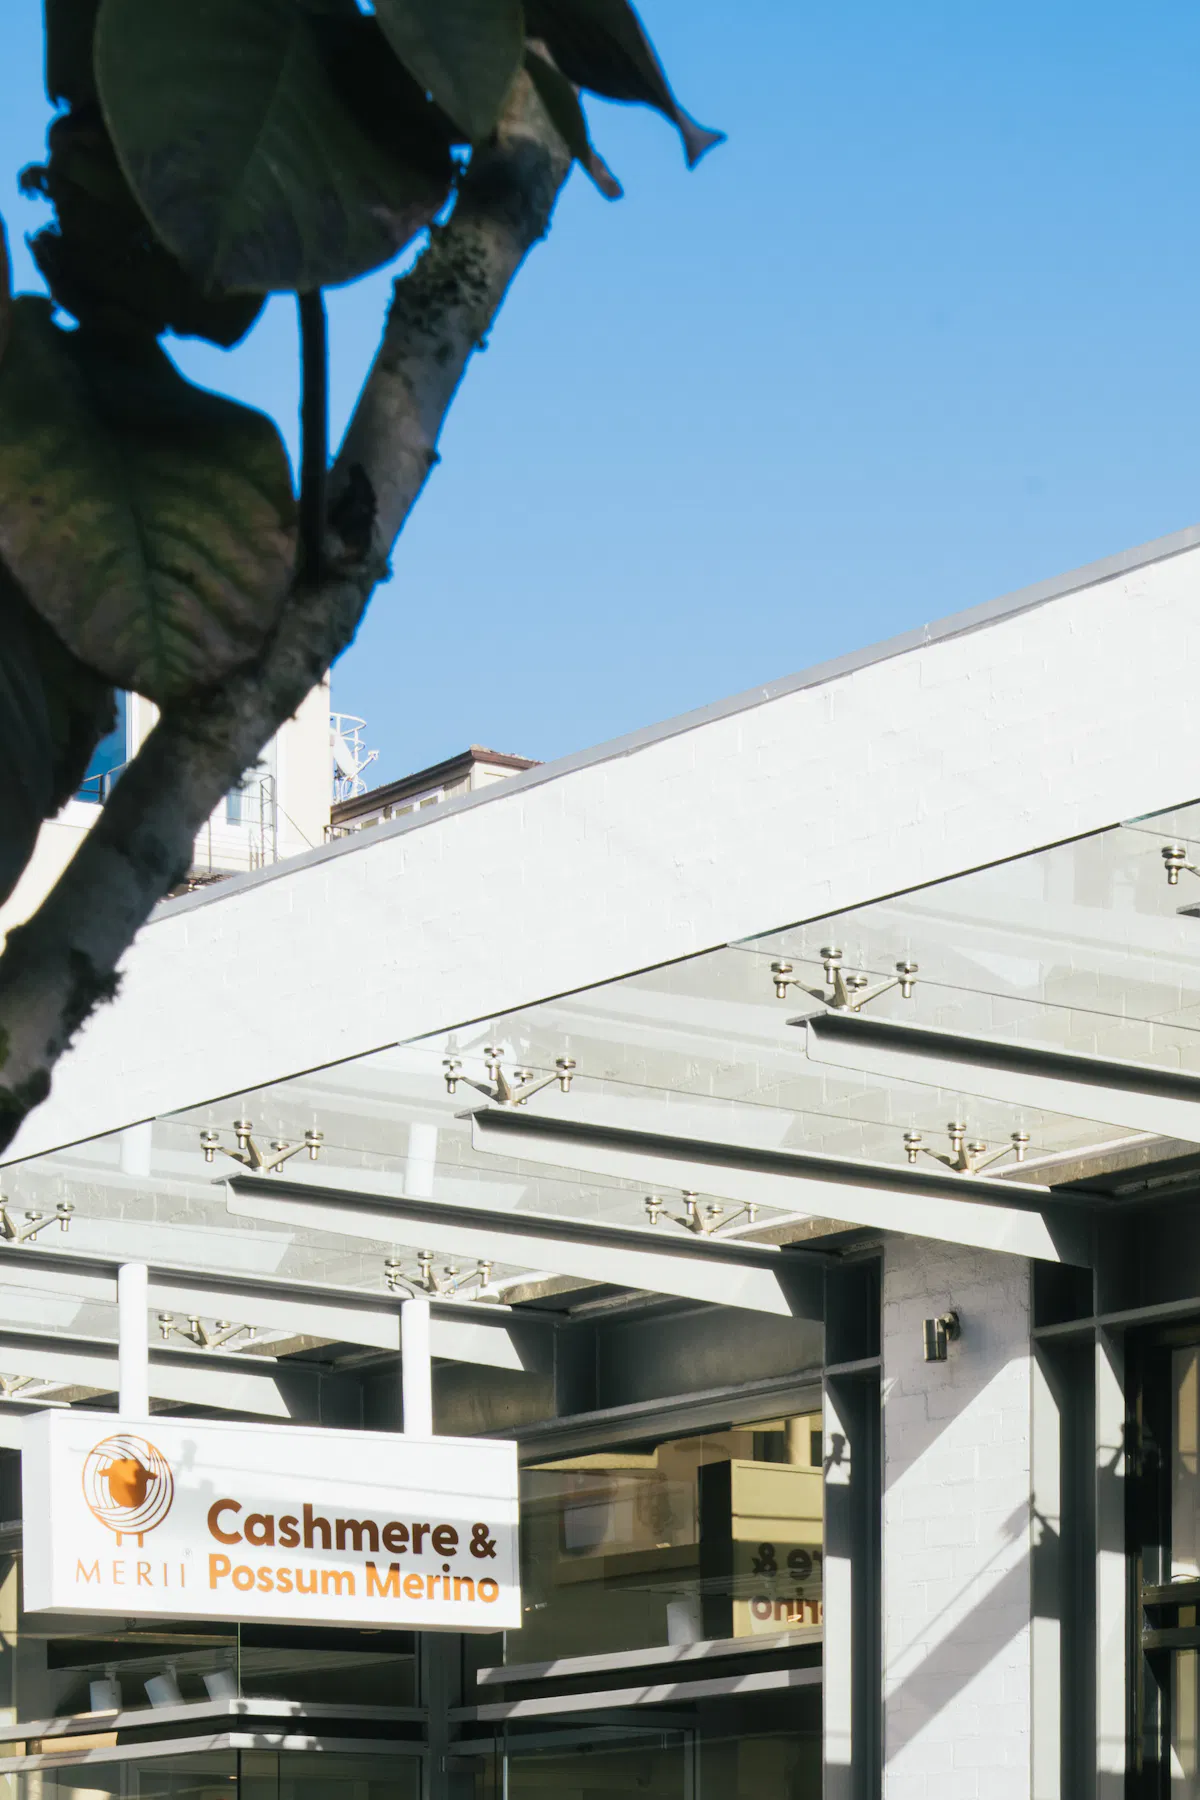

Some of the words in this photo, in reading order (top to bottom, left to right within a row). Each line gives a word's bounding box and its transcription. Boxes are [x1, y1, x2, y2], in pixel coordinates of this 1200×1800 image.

[207, 1498, 459, 1557] Cashmere
[469, 1522, 497, 1559] &
[75, 1557, 186, 1588] MERII
[208, 1553, 356, 1596] Possum
[365, 1561, 500, 1604] Merino
